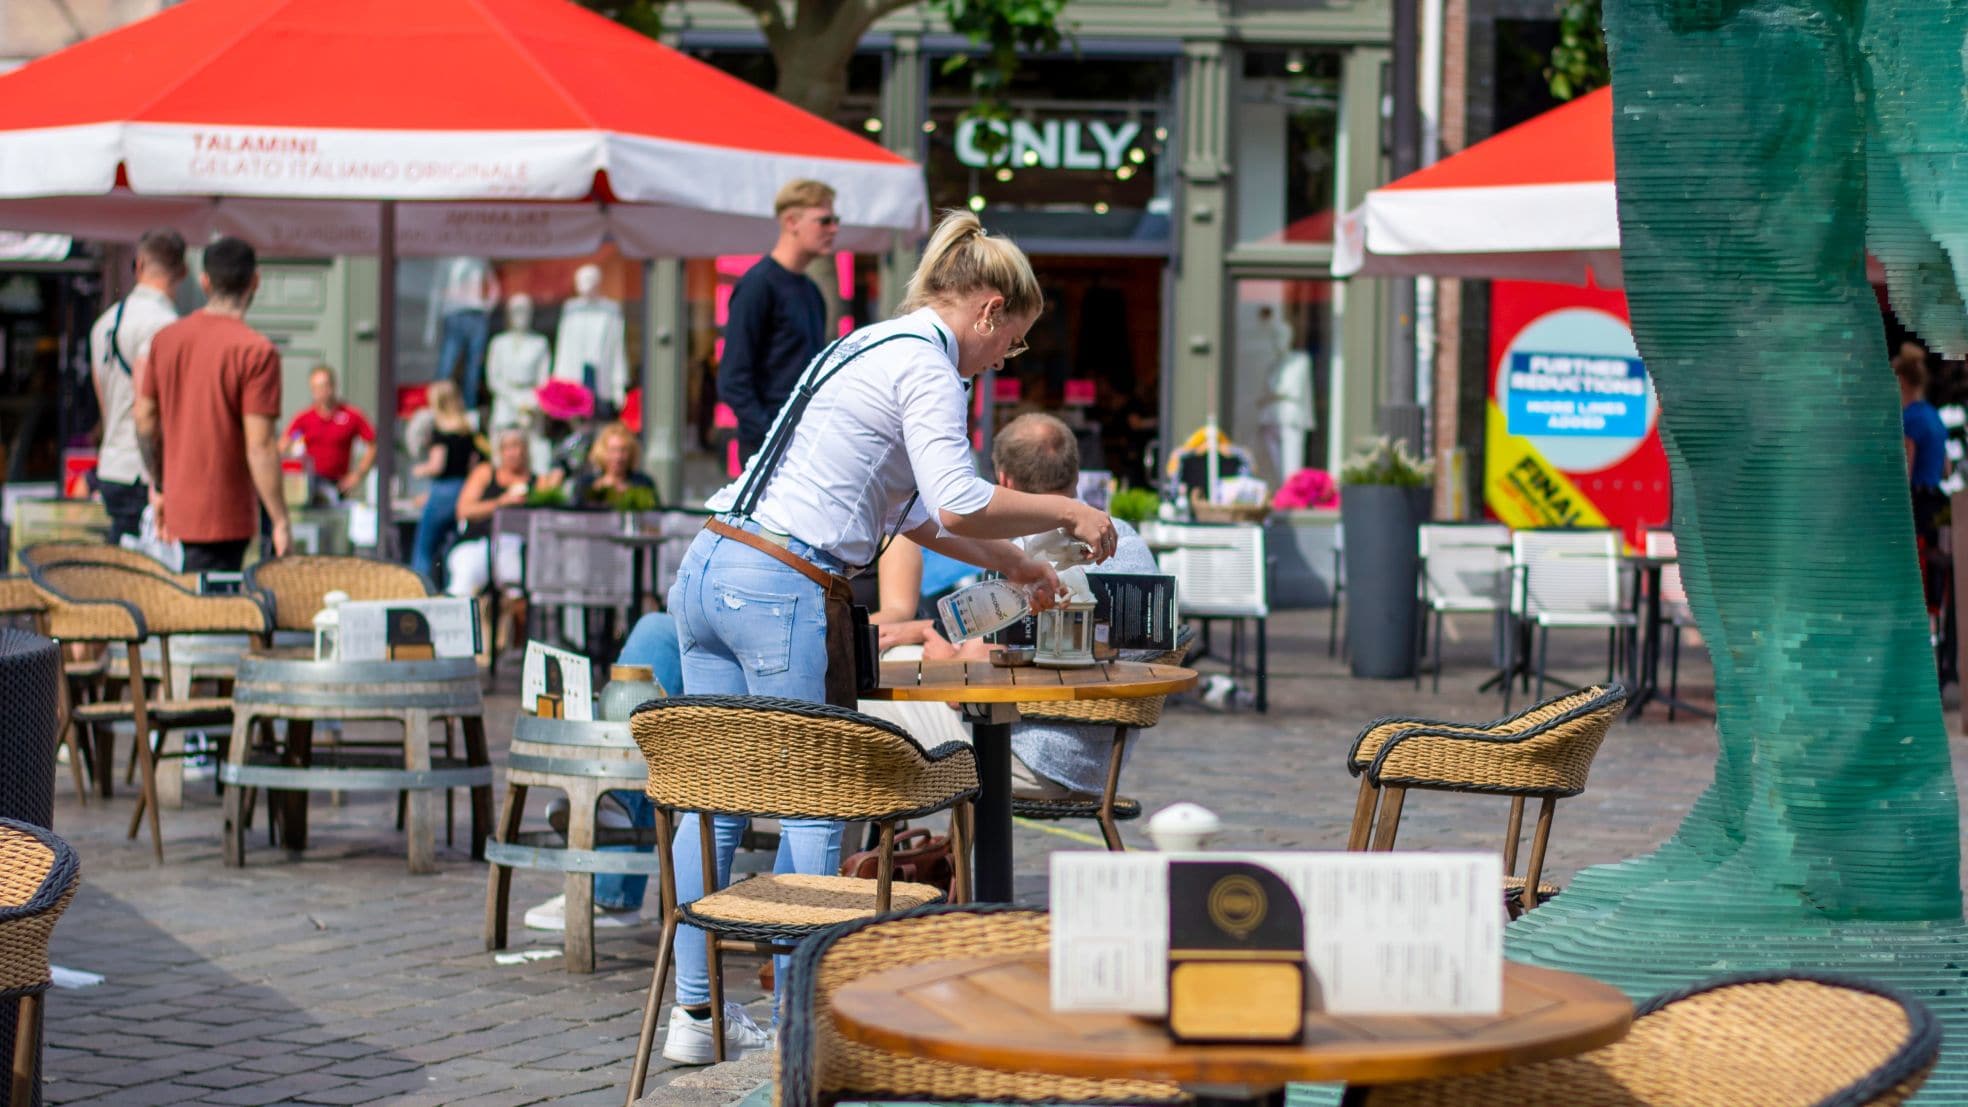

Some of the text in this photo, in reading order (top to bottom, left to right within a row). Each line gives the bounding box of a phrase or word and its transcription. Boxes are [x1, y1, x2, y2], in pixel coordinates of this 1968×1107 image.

[192, 133, 318, 154] TALAMINI
[955, 117, 1140, 169] ONLY
[189, 158, 529, 182] GELATO ITALIANO ORIGINALE
[1530, 355, 1629, 376] FURTHER
[1511, 372, 1644, 395] REDUCTIONS
[1526, 400, 1627, 416] MORE LINES
[1547, 415, 1606, 430] ADDED
